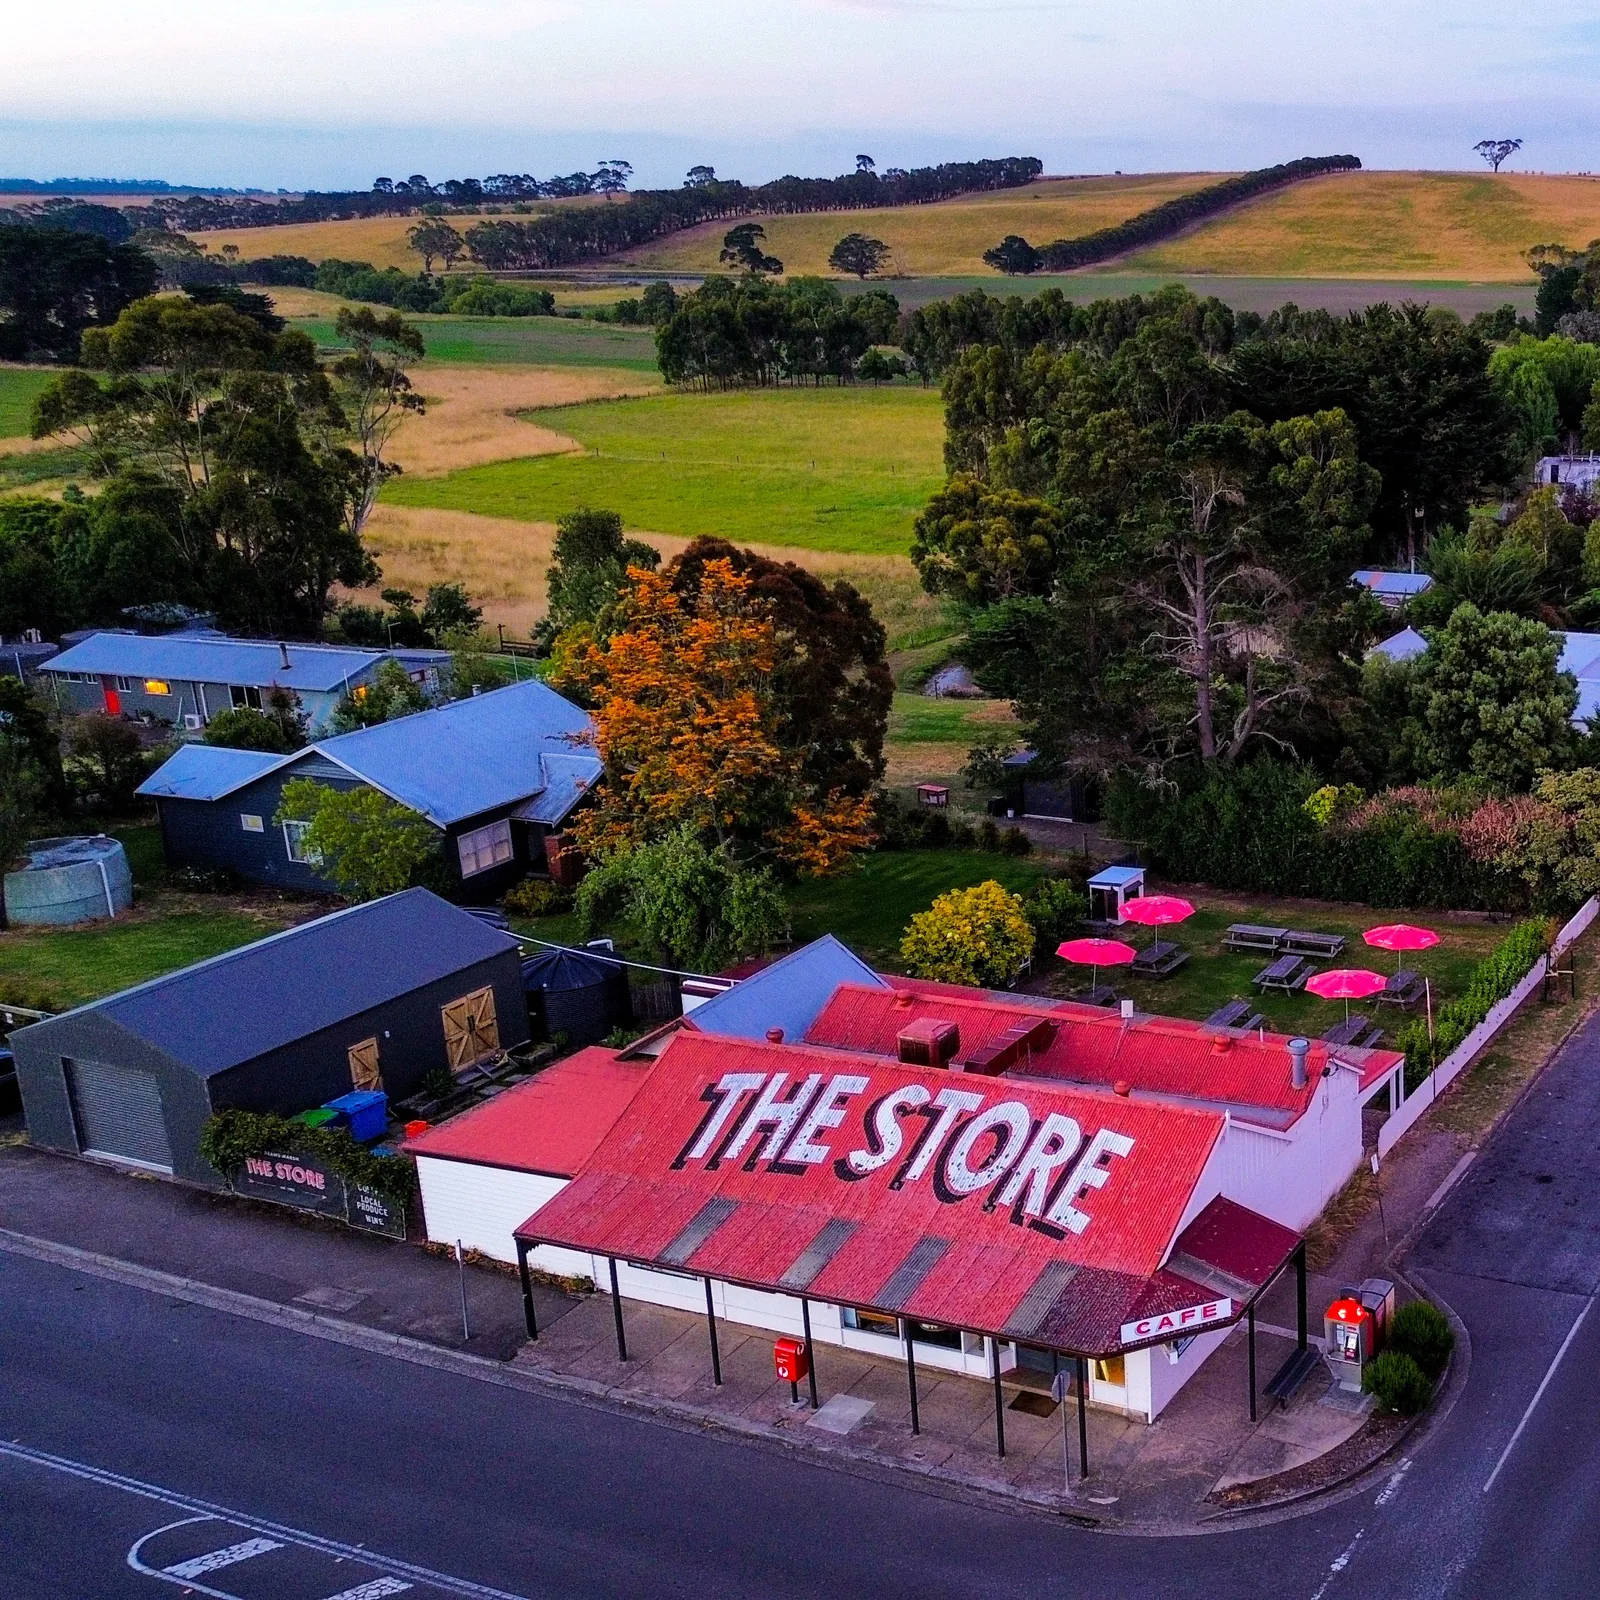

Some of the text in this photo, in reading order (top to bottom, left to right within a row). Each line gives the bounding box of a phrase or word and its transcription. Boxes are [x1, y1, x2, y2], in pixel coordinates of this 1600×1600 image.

[669, 1072, 1136, 1240] THE STORE
[245, 1157, 325, 1190] THE STORE
[356, 1201, 389, 1217] PRODUCE
[360, 1194, 383, 1208] LOCAL
[365, 1214, 385, 1226] WINE
[1135, 1303, 1217, 1335] CAFE
